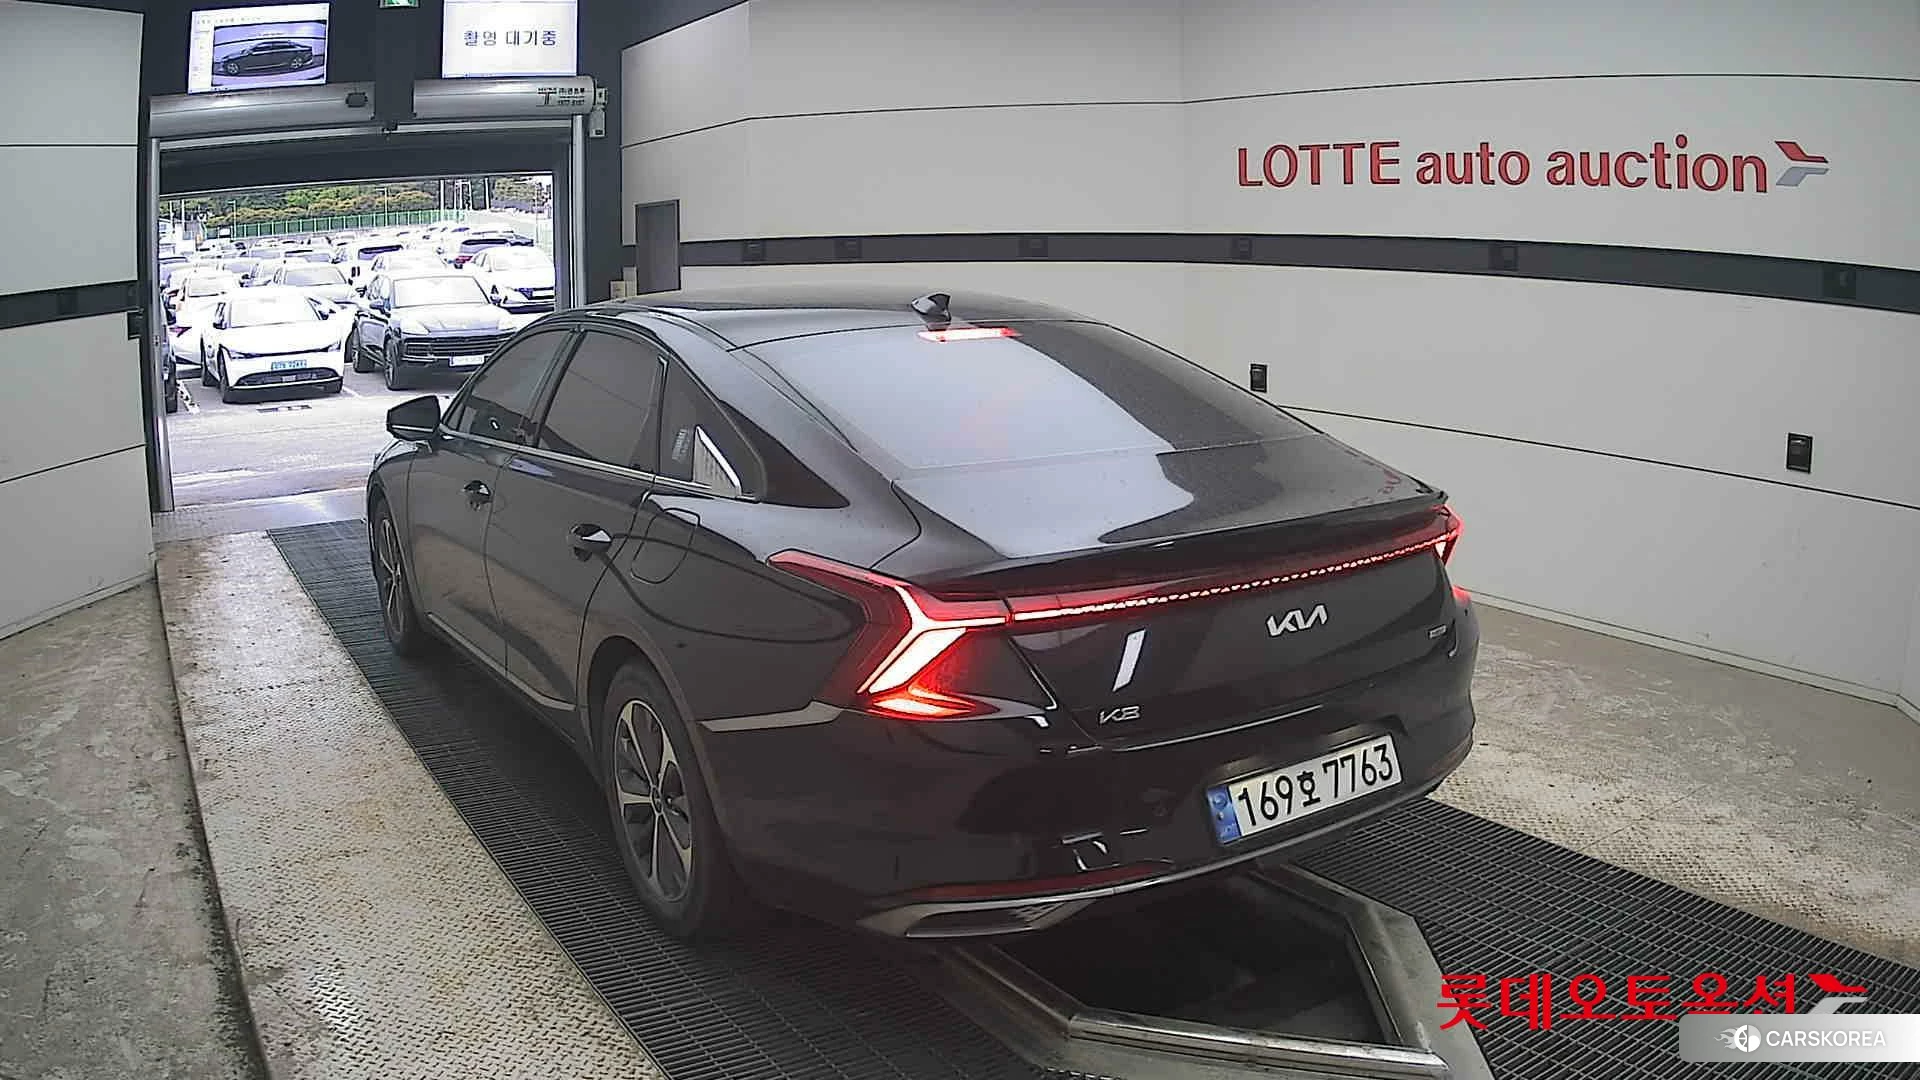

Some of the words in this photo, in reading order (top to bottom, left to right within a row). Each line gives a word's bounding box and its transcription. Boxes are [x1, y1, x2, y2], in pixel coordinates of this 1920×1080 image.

[464, 30, 497, 47] 촬영
[505, 29, 557, 46] 대기중
[1238, 141, 1400, 187] LOTTE
[1416, 142, 1531, 187] auto
[1546, 134, 1768, 193] auction
[1266, 604, 1328, 637] KIA
[1099, 705, 1141, 725] K8
[1238, 770, 1321, 827] 169호
[1322, 743, 1394, 799] 7763
